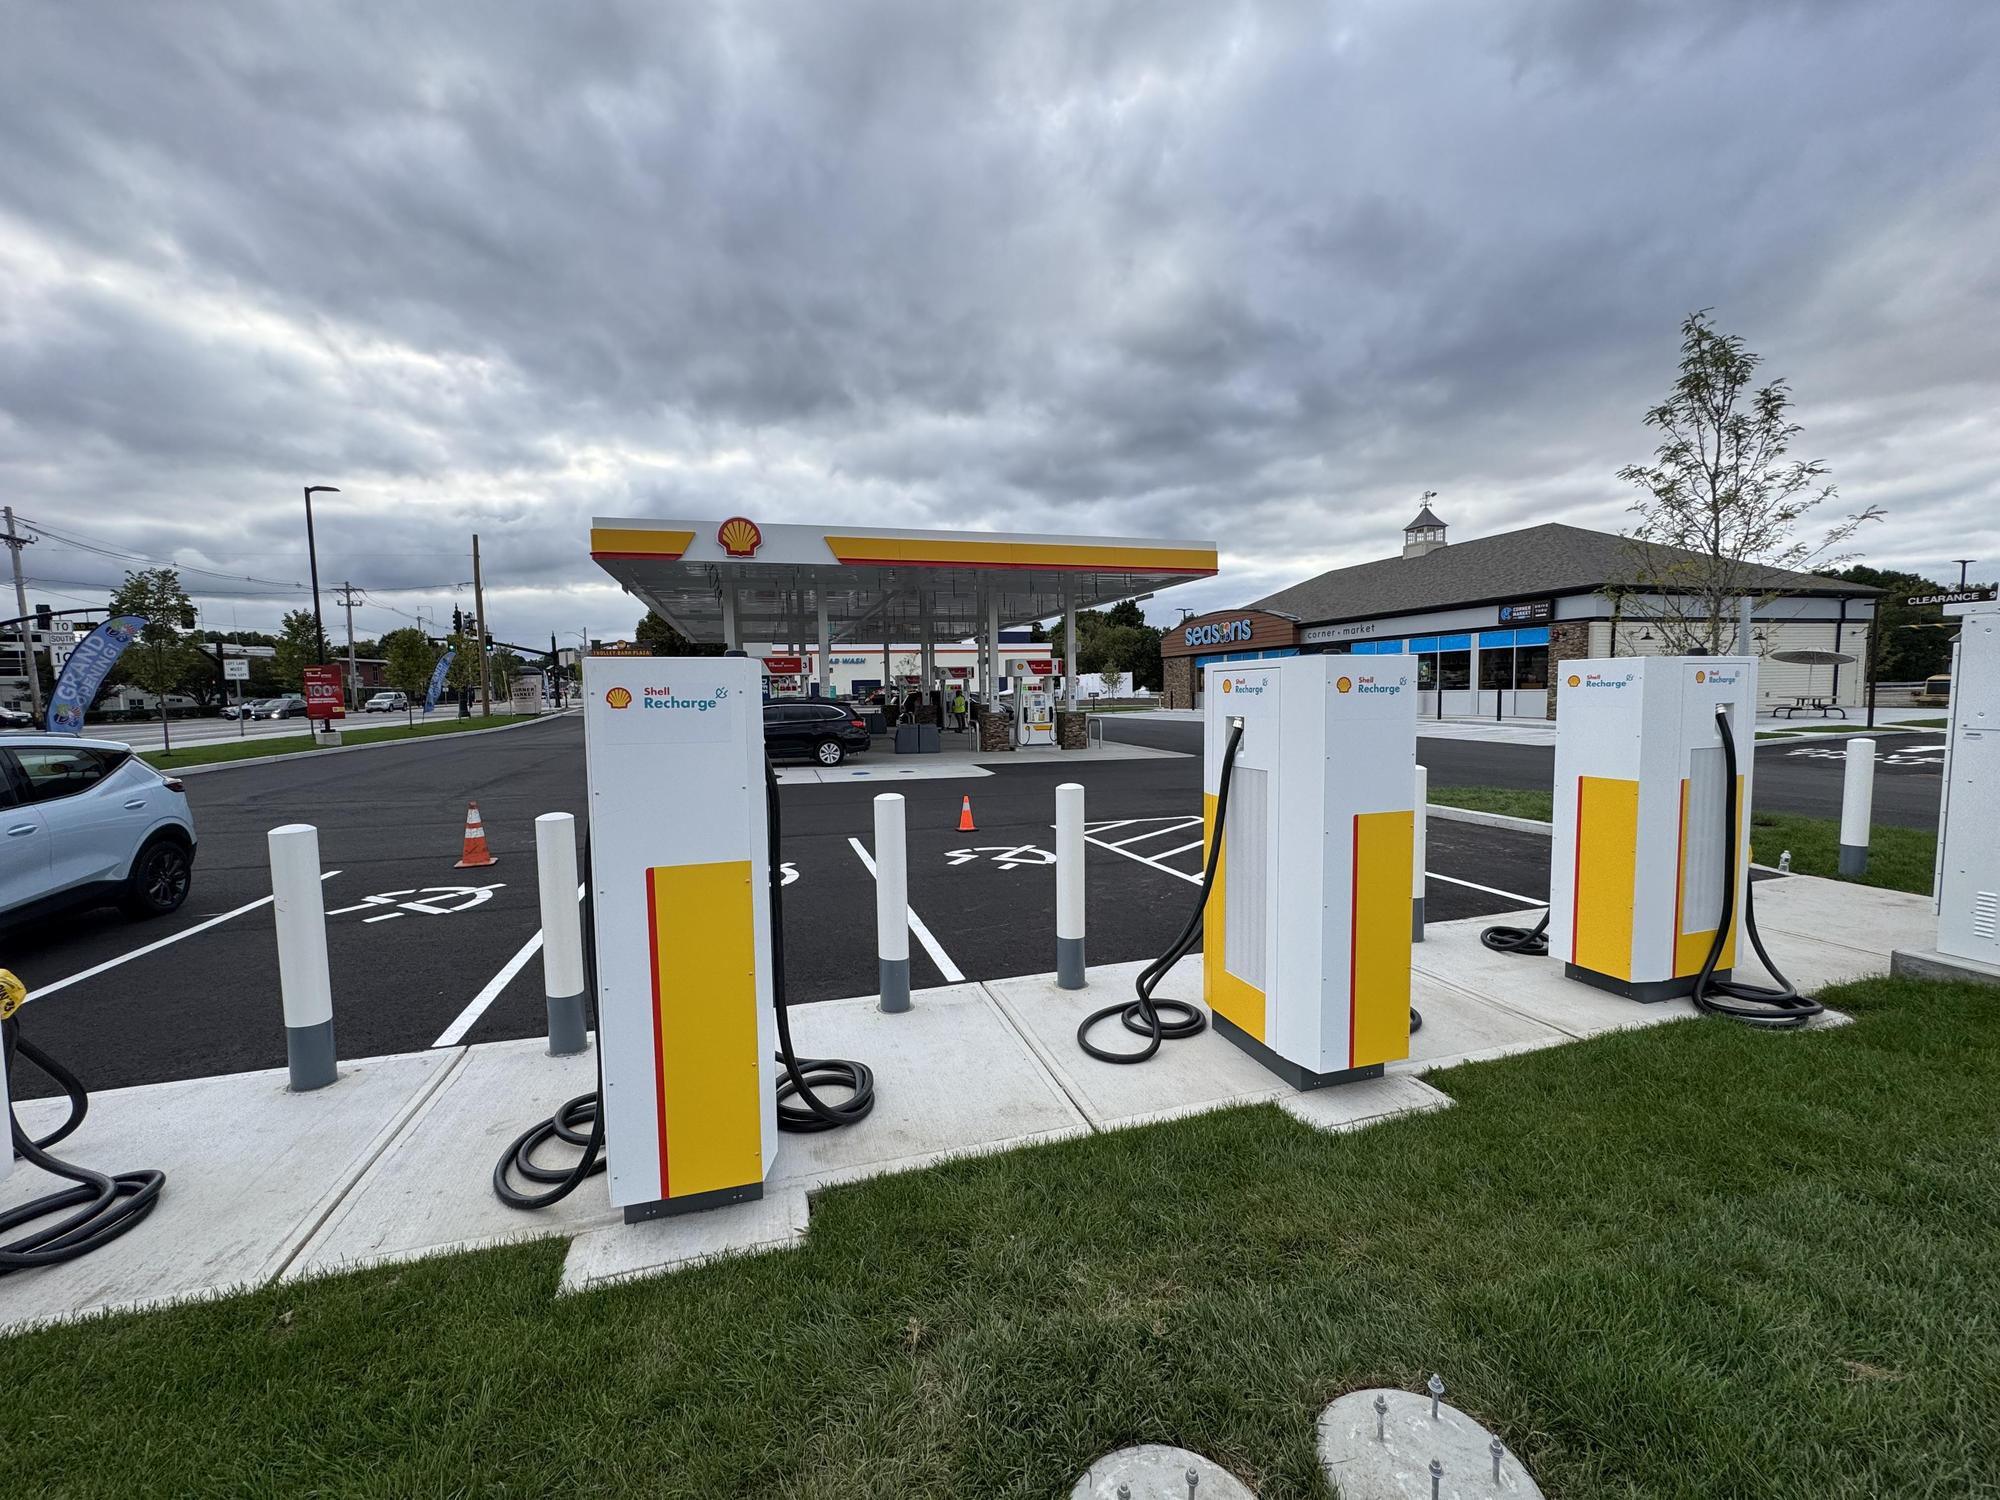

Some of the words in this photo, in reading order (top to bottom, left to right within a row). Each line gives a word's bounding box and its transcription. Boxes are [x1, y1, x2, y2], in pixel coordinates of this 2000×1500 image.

[1907, 592, 1980, 605] CLEARANCE
[54, 622, 69, 631] TO
[1307, 627, 1336, 639] corner
[1343, 623, 1376, 636] market
[1184, 618, 1252, 647] seasons
[842, 657, 866, 665] WASH
[57, 635, 105, 700] GRAND
[76, 643, 121, 706] OPENING!
[1358, 676, 1374, 684] Shell
[1586, 680, 1627, 689] Recharge
[1708, 676, 1736, 684] Recharge
[644, 687, 670, 696] Shell
[1235, 685, 1264, 695] Recharge
[1358, 684, 1401, 695] Recharge
[644, 696, 717, 711] Recharge
